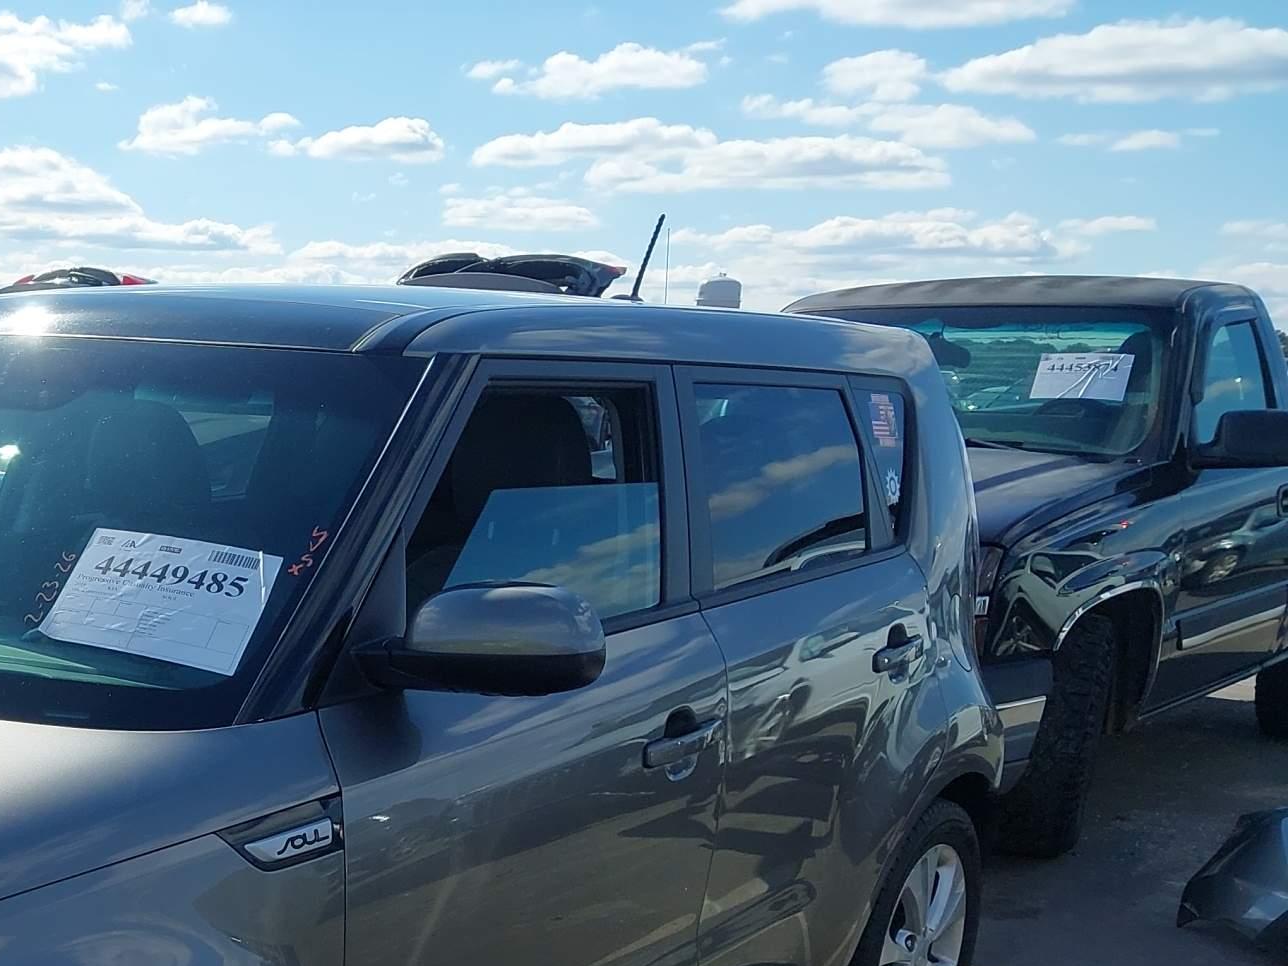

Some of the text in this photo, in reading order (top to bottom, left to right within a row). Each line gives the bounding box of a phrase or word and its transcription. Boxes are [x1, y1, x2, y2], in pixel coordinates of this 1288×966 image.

[24, 551, 77, 625] 2-23-26
[94, 555, 249, 598] 44449485
[122, 579, 156, 592] Caualty
[156, 584, 195, 598] Insurance
[277, 828, 330, 855] SOUL
